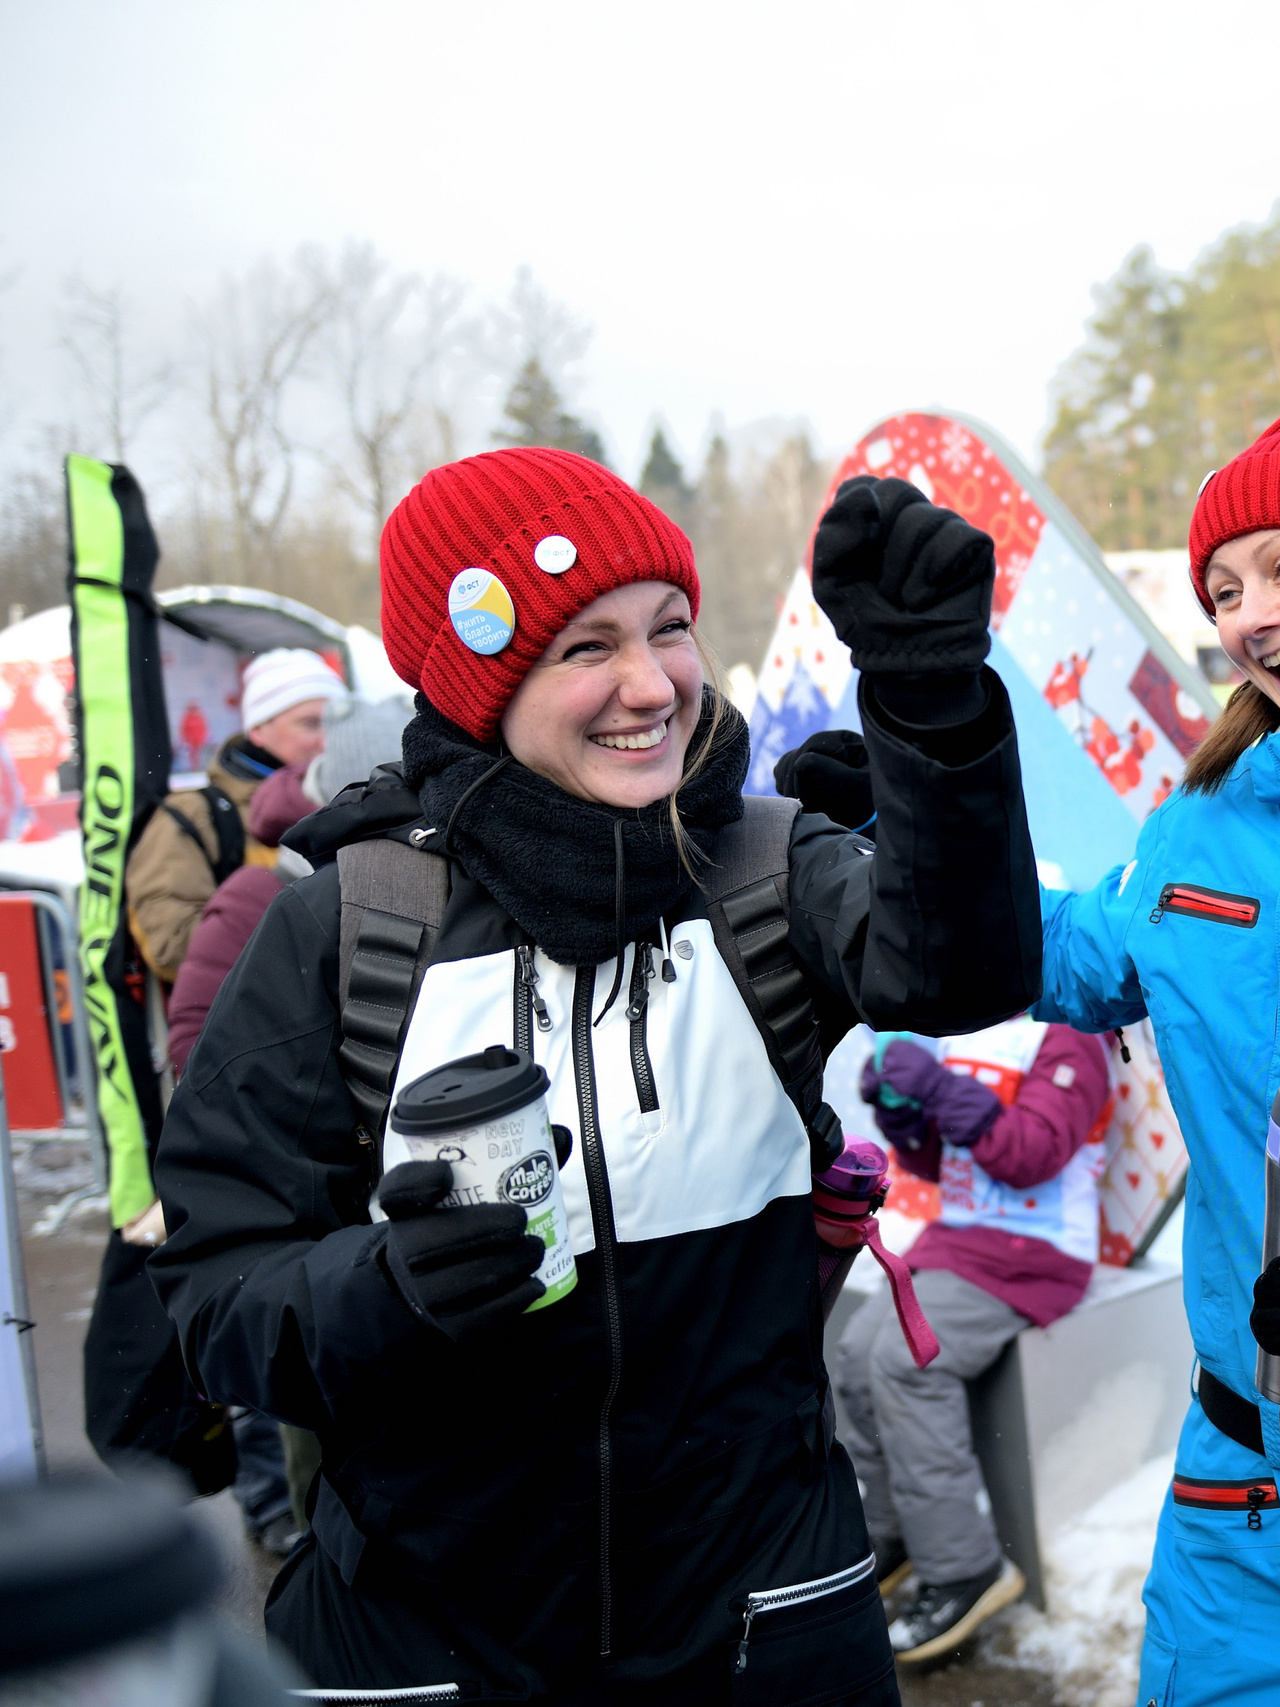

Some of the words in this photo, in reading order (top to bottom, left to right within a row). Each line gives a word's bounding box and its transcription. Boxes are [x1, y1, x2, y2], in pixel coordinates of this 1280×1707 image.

[466, 579, 480, 591] ФСТ
[456, 614, 486, 632] #жить
[464, 624, 492, 641] благо
[472, 630, 510, 649] творить
[488, 1137, 523, 1160] DAY
[441, 1184, 483, 1207] ATTE
